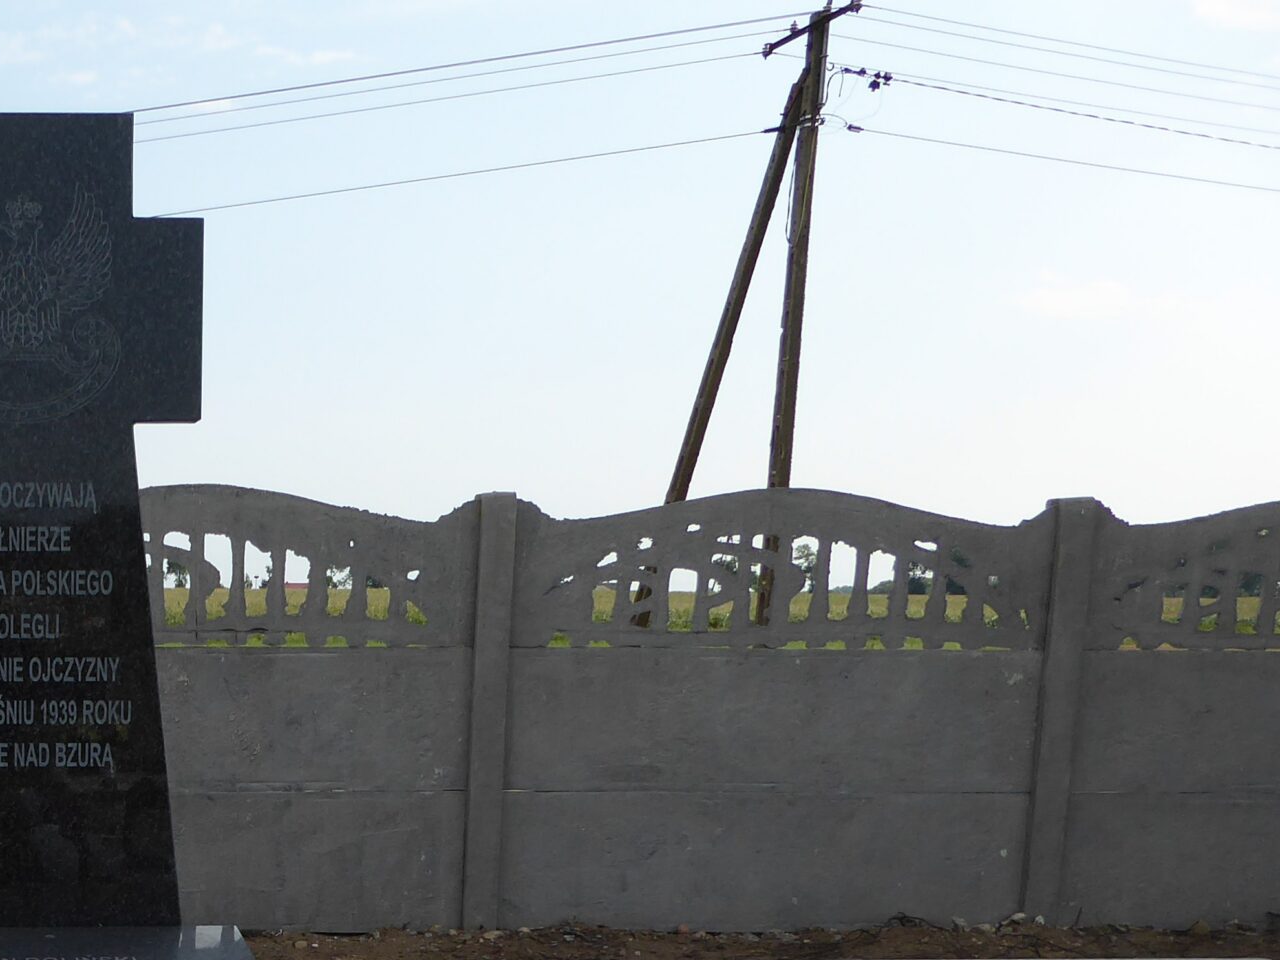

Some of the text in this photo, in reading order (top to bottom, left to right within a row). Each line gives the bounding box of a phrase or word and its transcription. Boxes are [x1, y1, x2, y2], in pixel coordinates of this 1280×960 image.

[11, 570, 113, 596] POLSKIEGO
[29, 656, 120, 683] OJCZYZNY
[40, 700, 77, 726] 1939
[81, 700, 133, 726] ROKU
[13, 742, 50, 768] NAD
[54, 742, 115, 777] BZURĄ
